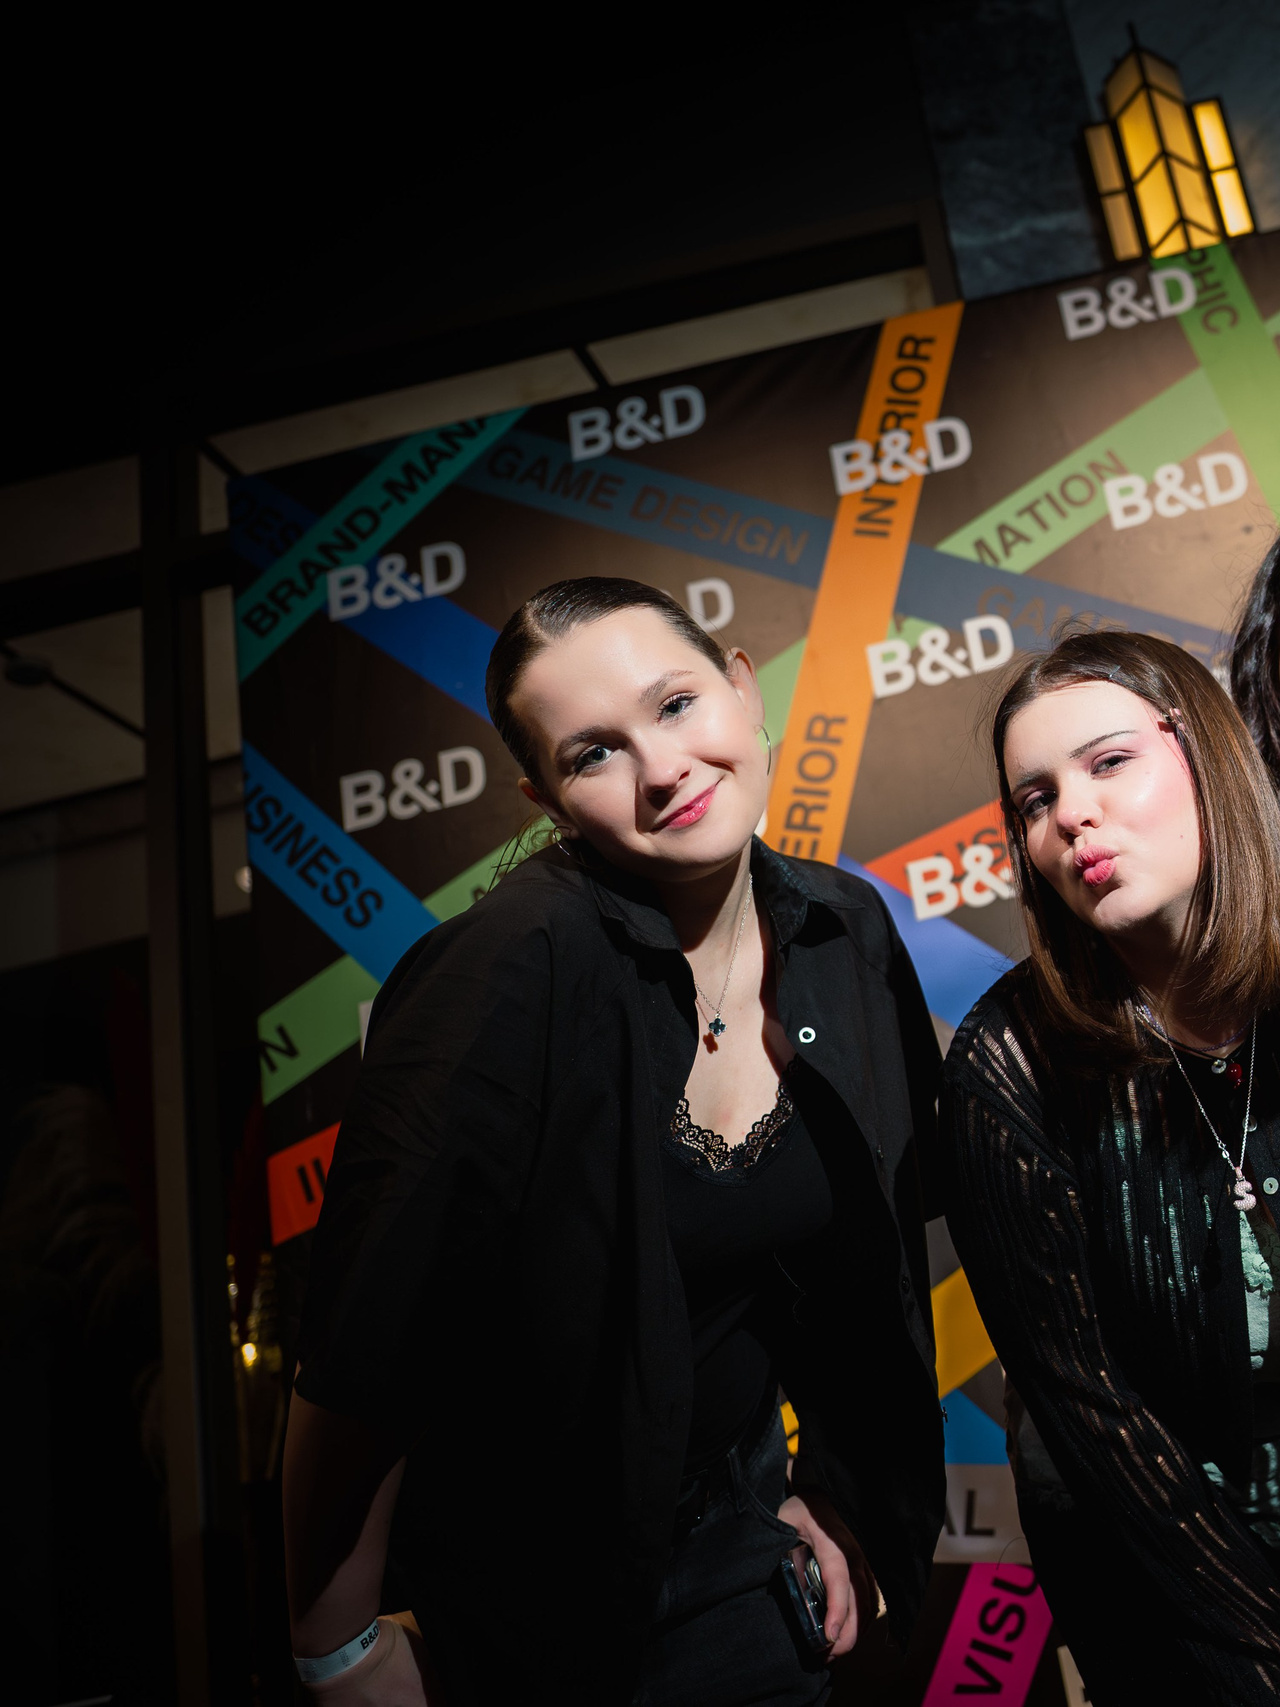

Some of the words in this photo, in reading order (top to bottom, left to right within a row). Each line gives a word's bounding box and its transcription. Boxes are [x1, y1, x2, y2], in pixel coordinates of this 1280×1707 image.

[1056, 266, 1200, 342] B&D
[568, 384, 707, 462] B&D
[829, 416, 972, 496] B&D
[853, 333, 936, 539] INRIOR
[487, 444, 625, 512] GAME
[628, 484, 811, 565] DESIGN
[1103, 451, 1248, 531] B&D
[326, 540, 467, 622] B&D
[866, 614, 1015, 699] B&D
[340, 746, 487, 833] B&D
